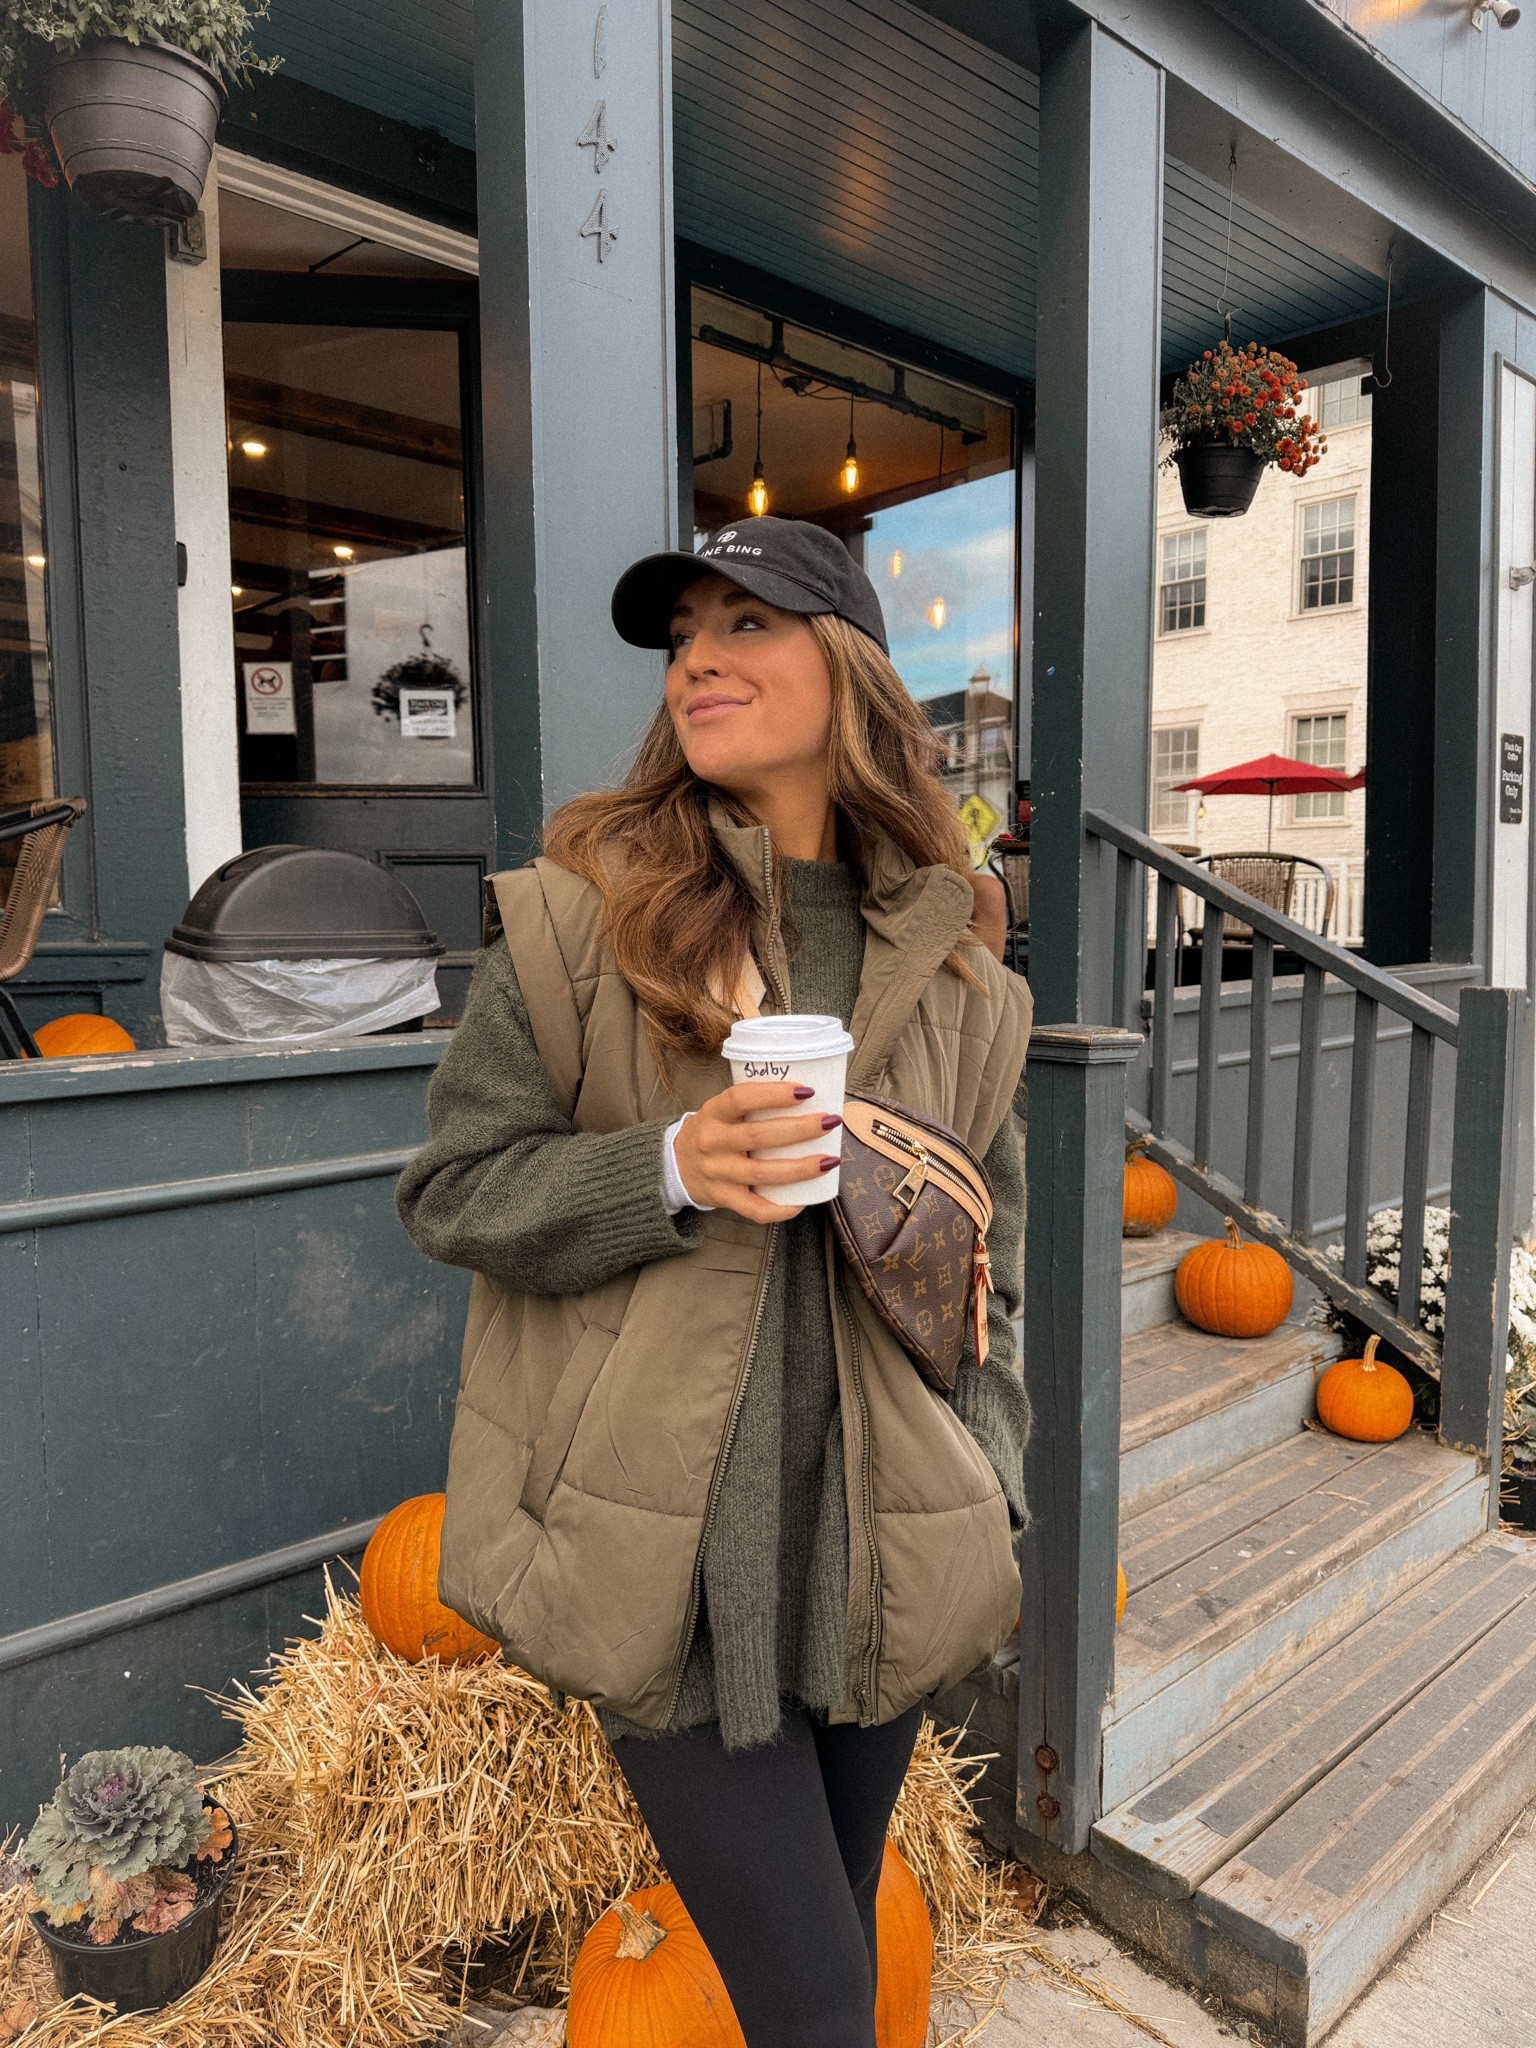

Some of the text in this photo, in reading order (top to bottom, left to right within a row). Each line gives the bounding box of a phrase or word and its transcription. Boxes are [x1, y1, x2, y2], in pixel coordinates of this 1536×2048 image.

[726, 544, 763, 556] BING
[1502, 770, 1522, 785] Parking
[1505, 784, 1519, 799] Only
[743, 1062, 789, 1080] Shelby
